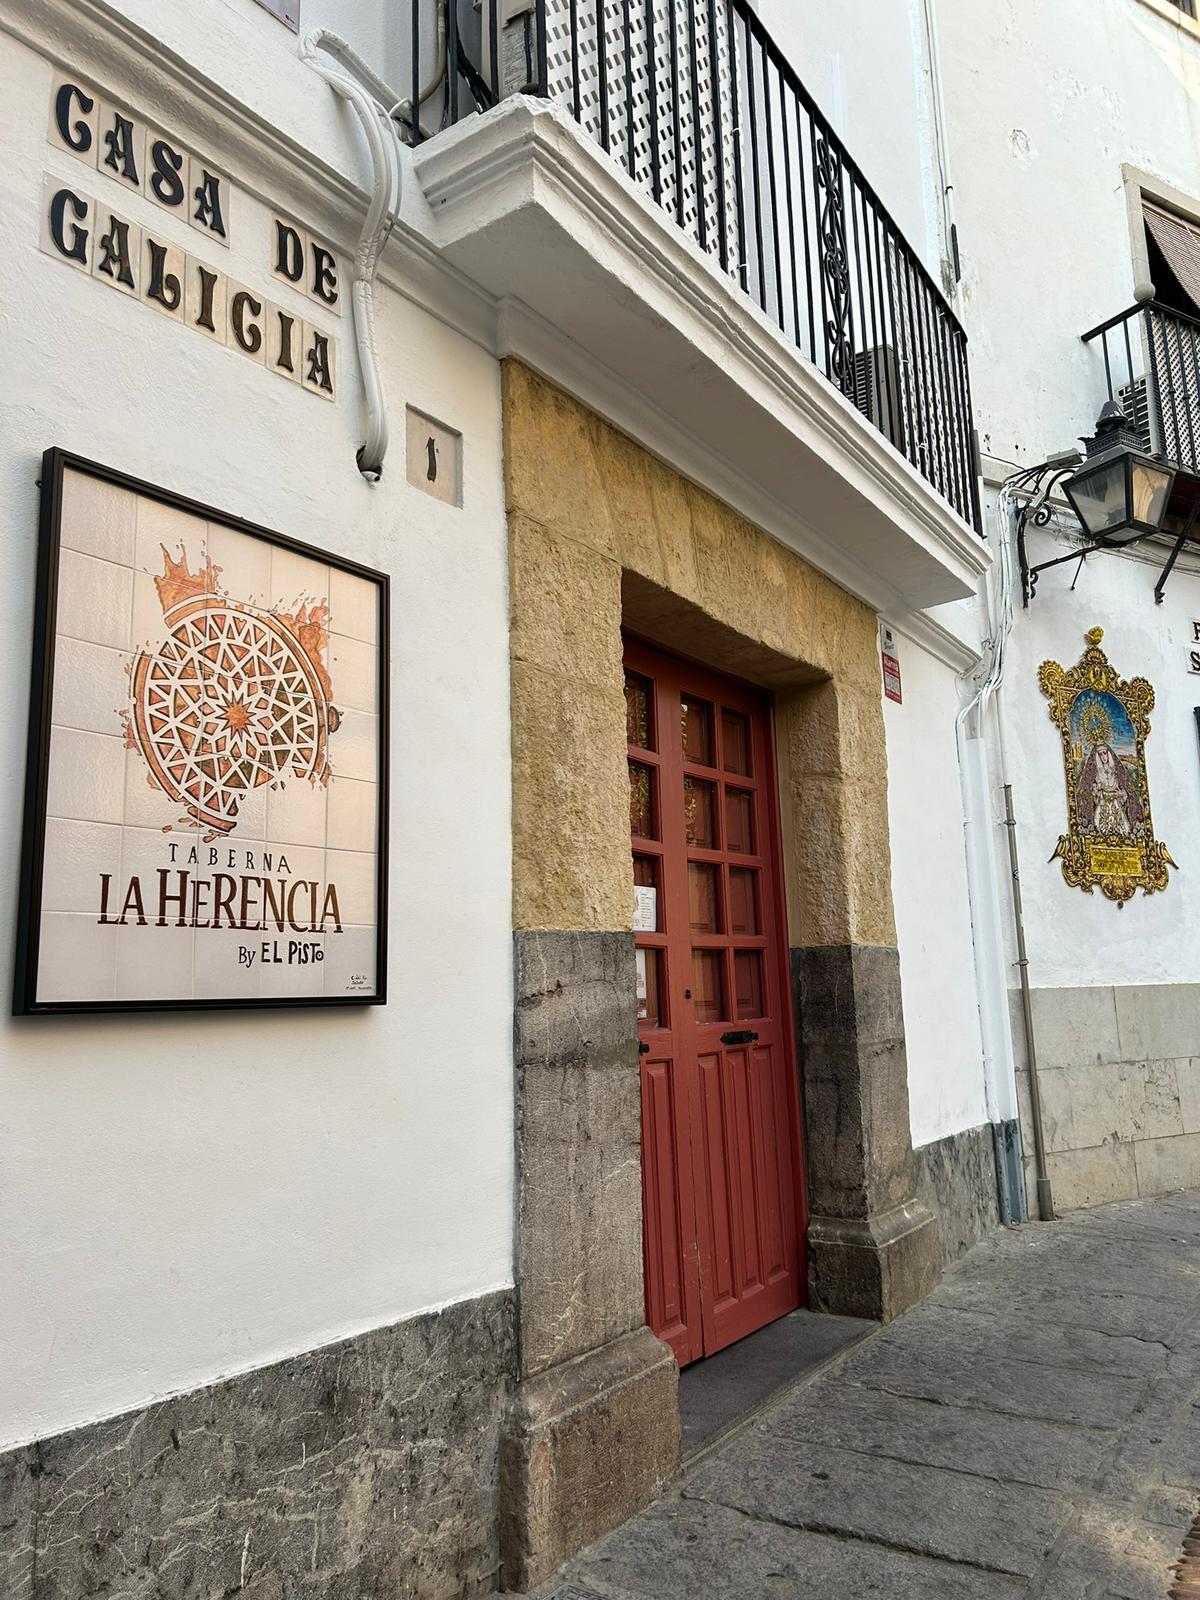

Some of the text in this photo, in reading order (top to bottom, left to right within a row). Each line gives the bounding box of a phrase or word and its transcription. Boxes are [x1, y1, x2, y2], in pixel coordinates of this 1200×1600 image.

[56, 84, 338, 305] CASA DE
[51, 188, 334, 394] GALICIA
[425, 436, 437, 483] 1
[168, 843, 292, 874] TABERNA
[97, 868, 344, 934] LA HERENCIA
[238, 945, 256, 968] By
[261, 941, 282, 963] EL
